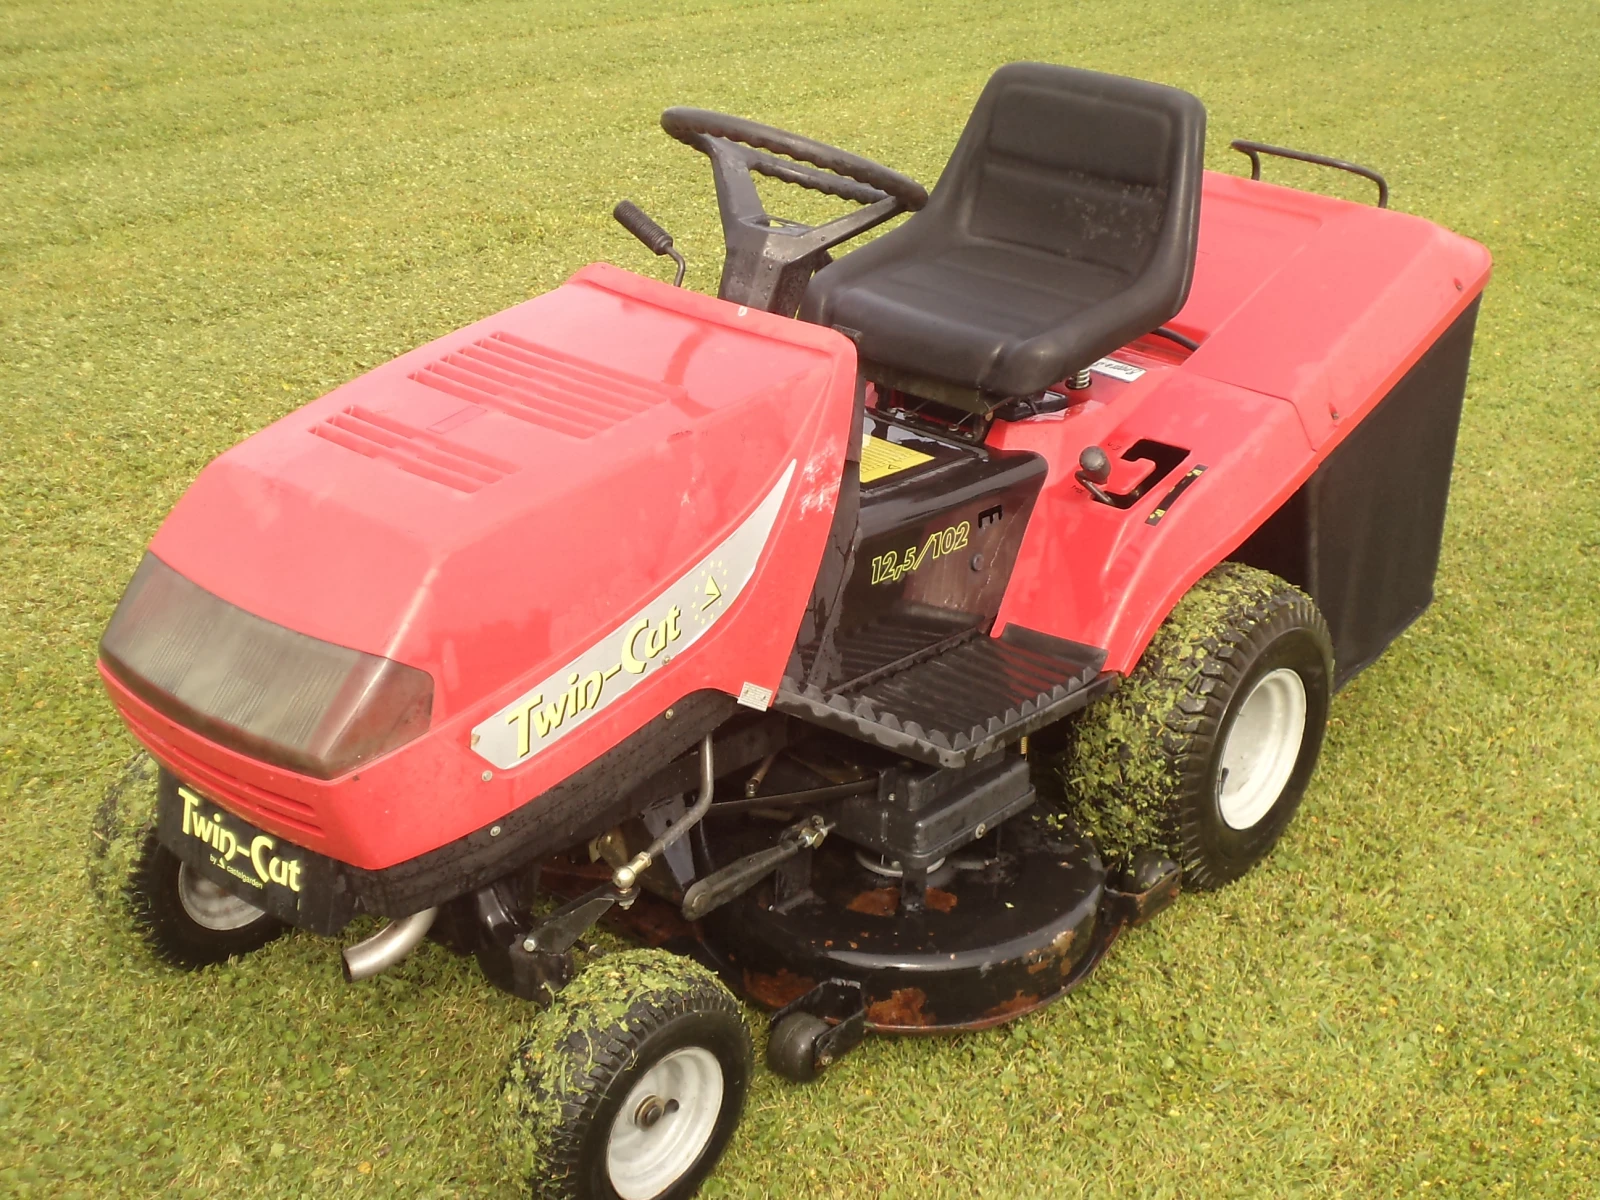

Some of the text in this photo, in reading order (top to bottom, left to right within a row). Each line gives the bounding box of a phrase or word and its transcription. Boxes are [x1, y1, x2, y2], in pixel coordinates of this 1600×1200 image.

[871, 521, 970, 584] 12,5/102
[505, 605, 681, 758] Twin-Cut
[178, 787, 301, 892] Twin-Cut
[210, 854, 217, 865] by
